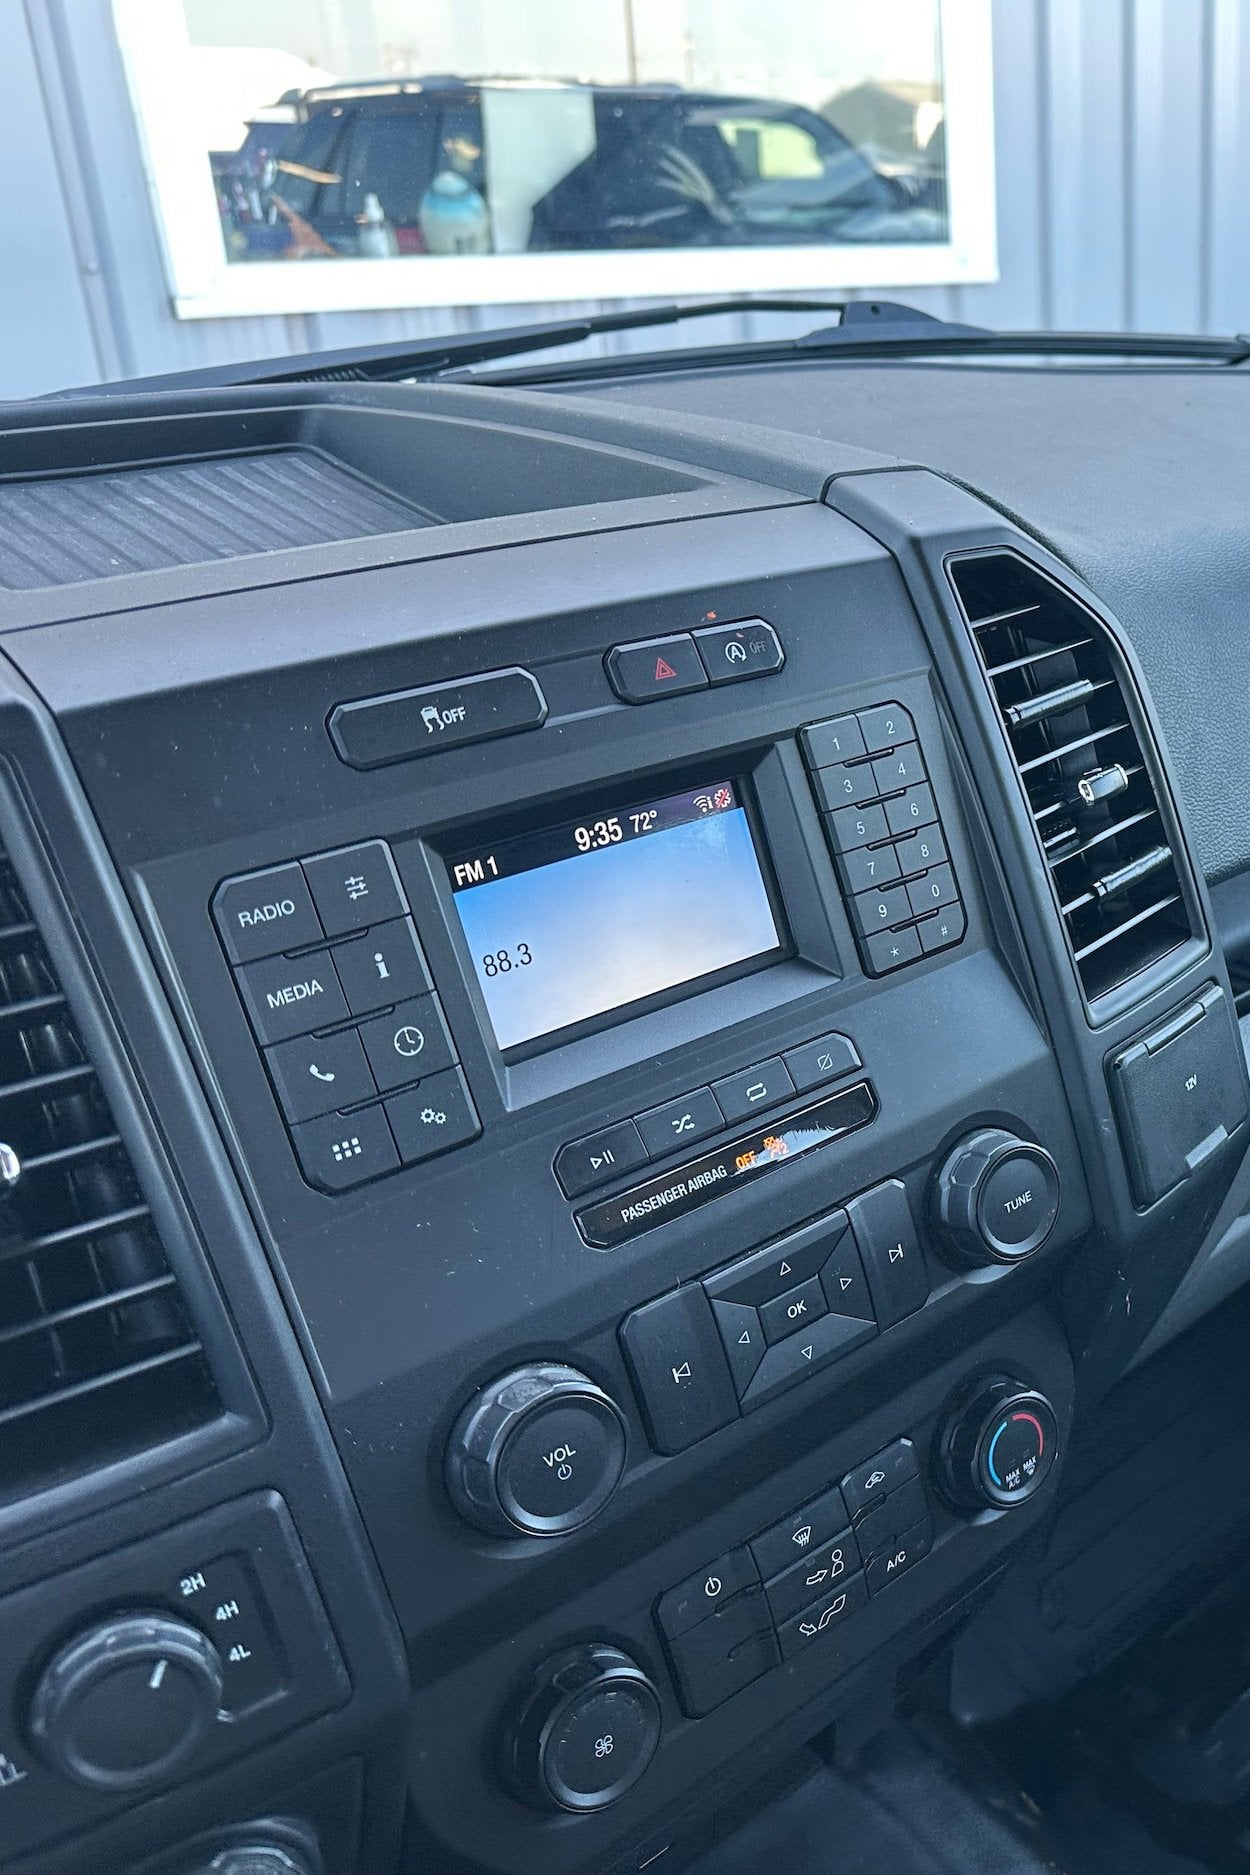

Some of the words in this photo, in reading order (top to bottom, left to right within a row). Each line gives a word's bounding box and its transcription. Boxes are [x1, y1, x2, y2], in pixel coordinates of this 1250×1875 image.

[750, 641, 768, 654] OFF
[442, 706, 466, 725] OFF
[886, 721, 896, 735] 2
[832, 737, 841, 750] 1
[898, 762, 906, 775] 4
[843, 779, 853, 793] 3
[910, 803, 919, 816] 6
[574, 818, 623, 851] 9:35
[629, 810, 658, 833] 72°
[856, 821, 866, 835] 5
[921, 844, 930, 858] 8
[454, 859, 485, 886] FM
[487, 856, 498, 876] 1
[867, 862, 876, 876] 7
[931, 884, 940, 898] 0
[238, 900, 296, 928] RADIO
[878, 904, 888, 918] 9
[483, 943, 533, 977] 88.3
[266, 979, 324, 1009] MEDIA
[1185, 1074, 1197, 1091] 12V
[620, 1184, 688, 1223] PASSENGER
[687, 1165, 727, 1194] AIRBAG
[735, 1150, 757, 1169] OFF
[1004, 1190, 1033, 1213] TUNE
[787, 1299, 807, 1318] OK
[542, 1443, 577, 1467] VOL
[1022, 1456, 1037, 1471] MAX
[1005, 1467, 1021, 1483] MAX
[1008, 1475, 1021, 1490] A/C
[886, 1550, 907, 1572] A/C
[180, 1572, 206, 1596] 2H
[215, 1600, 240, 1621] 4H
[229, 1644, 251, 1661] 4L
